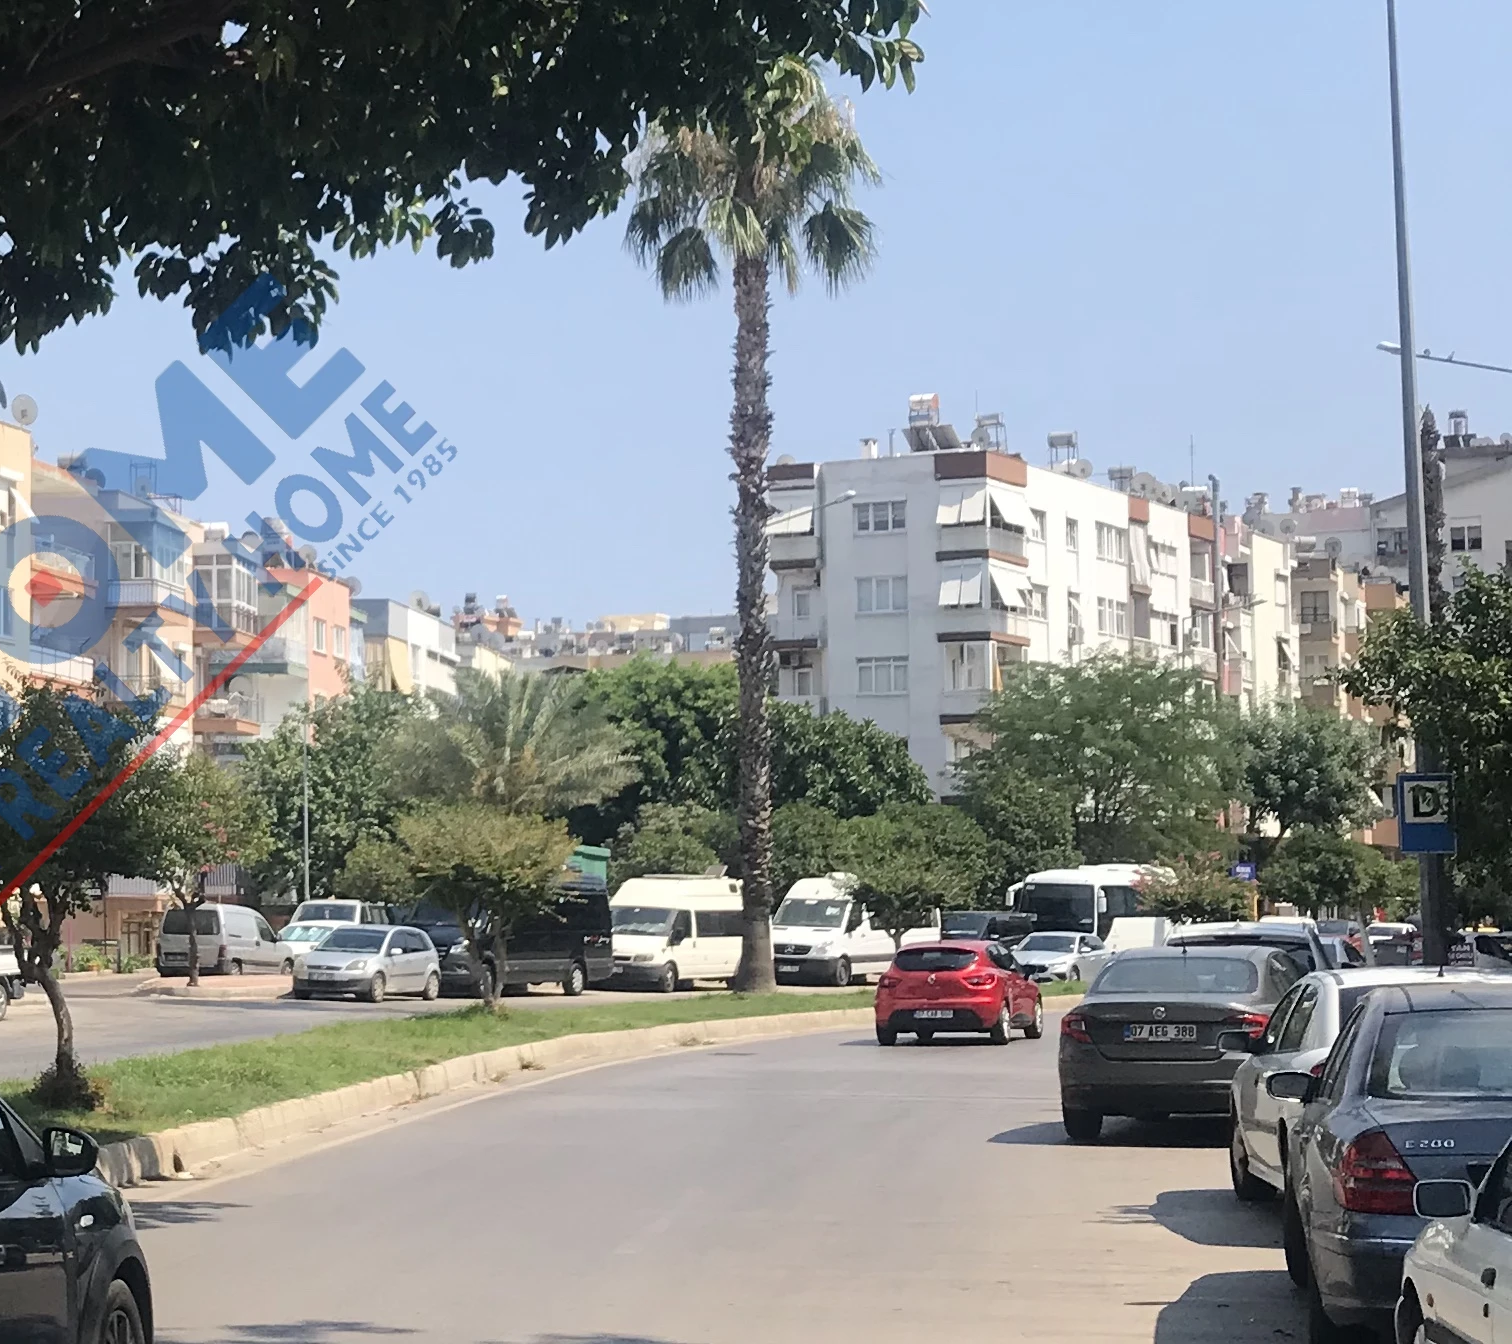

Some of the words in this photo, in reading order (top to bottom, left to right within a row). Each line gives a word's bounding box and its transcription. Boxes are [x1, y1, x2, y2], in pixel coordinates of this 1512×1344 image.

[1131, 1024, 1145, 1037] 07
[1405, 1140, 1415, 1149] E
[1419, 1138, 1455, 1149] 200
